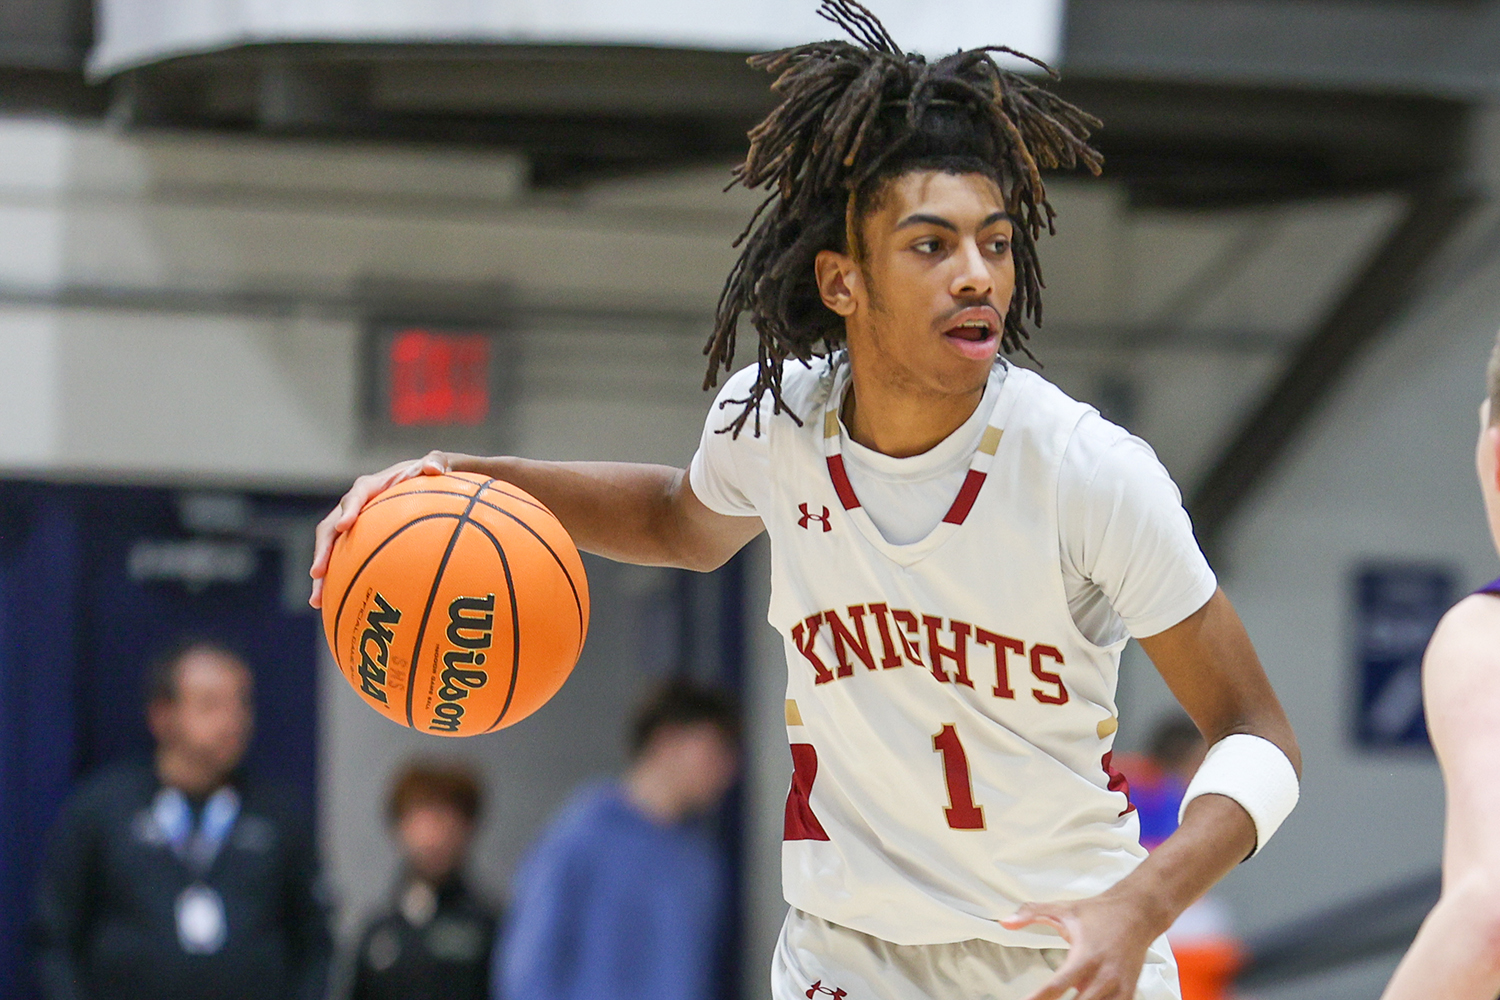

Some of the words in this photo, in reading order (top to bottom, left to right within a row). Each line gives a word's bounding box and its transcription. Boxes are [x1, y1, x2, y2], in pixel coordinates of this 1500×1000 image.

[358, 591, 402, 704] NCAA
[429, 592, 496, 733] Wilson
[790, 601, 1070, 706] KNIGHTS
[931, 722, 987, 831] 1
